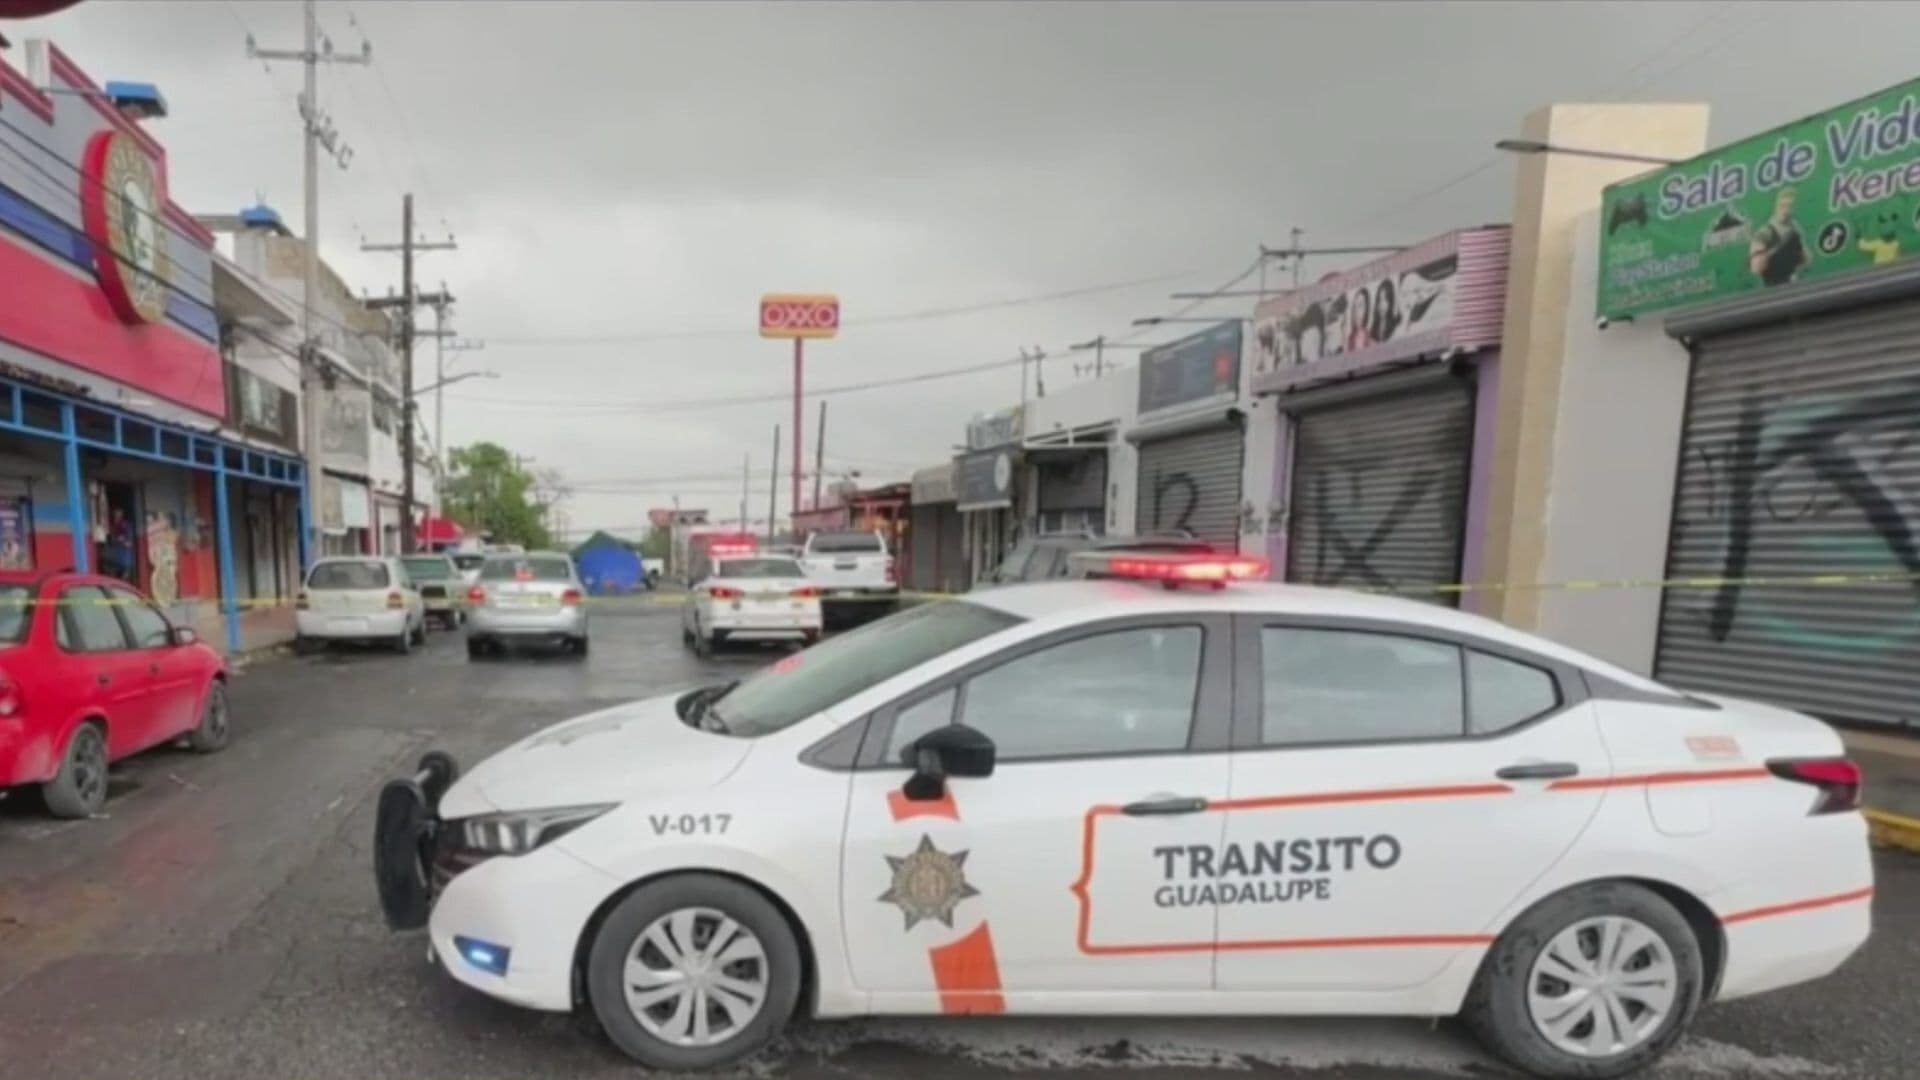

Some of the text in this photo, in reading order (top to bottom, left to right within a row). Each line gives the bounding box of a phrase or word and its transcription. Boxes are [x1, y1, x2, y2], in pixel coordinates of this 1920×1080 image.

[1658, 159, 1747, 220] Sala
[1755, 139, 1816, 191] de
[763, 303, 837, 328] OXXO
[648, 813, 732, 836] V-017
[1154, 833, 1402, 880] TRANSITO
[1154, 877, 1331, 908] GUADALUPE
